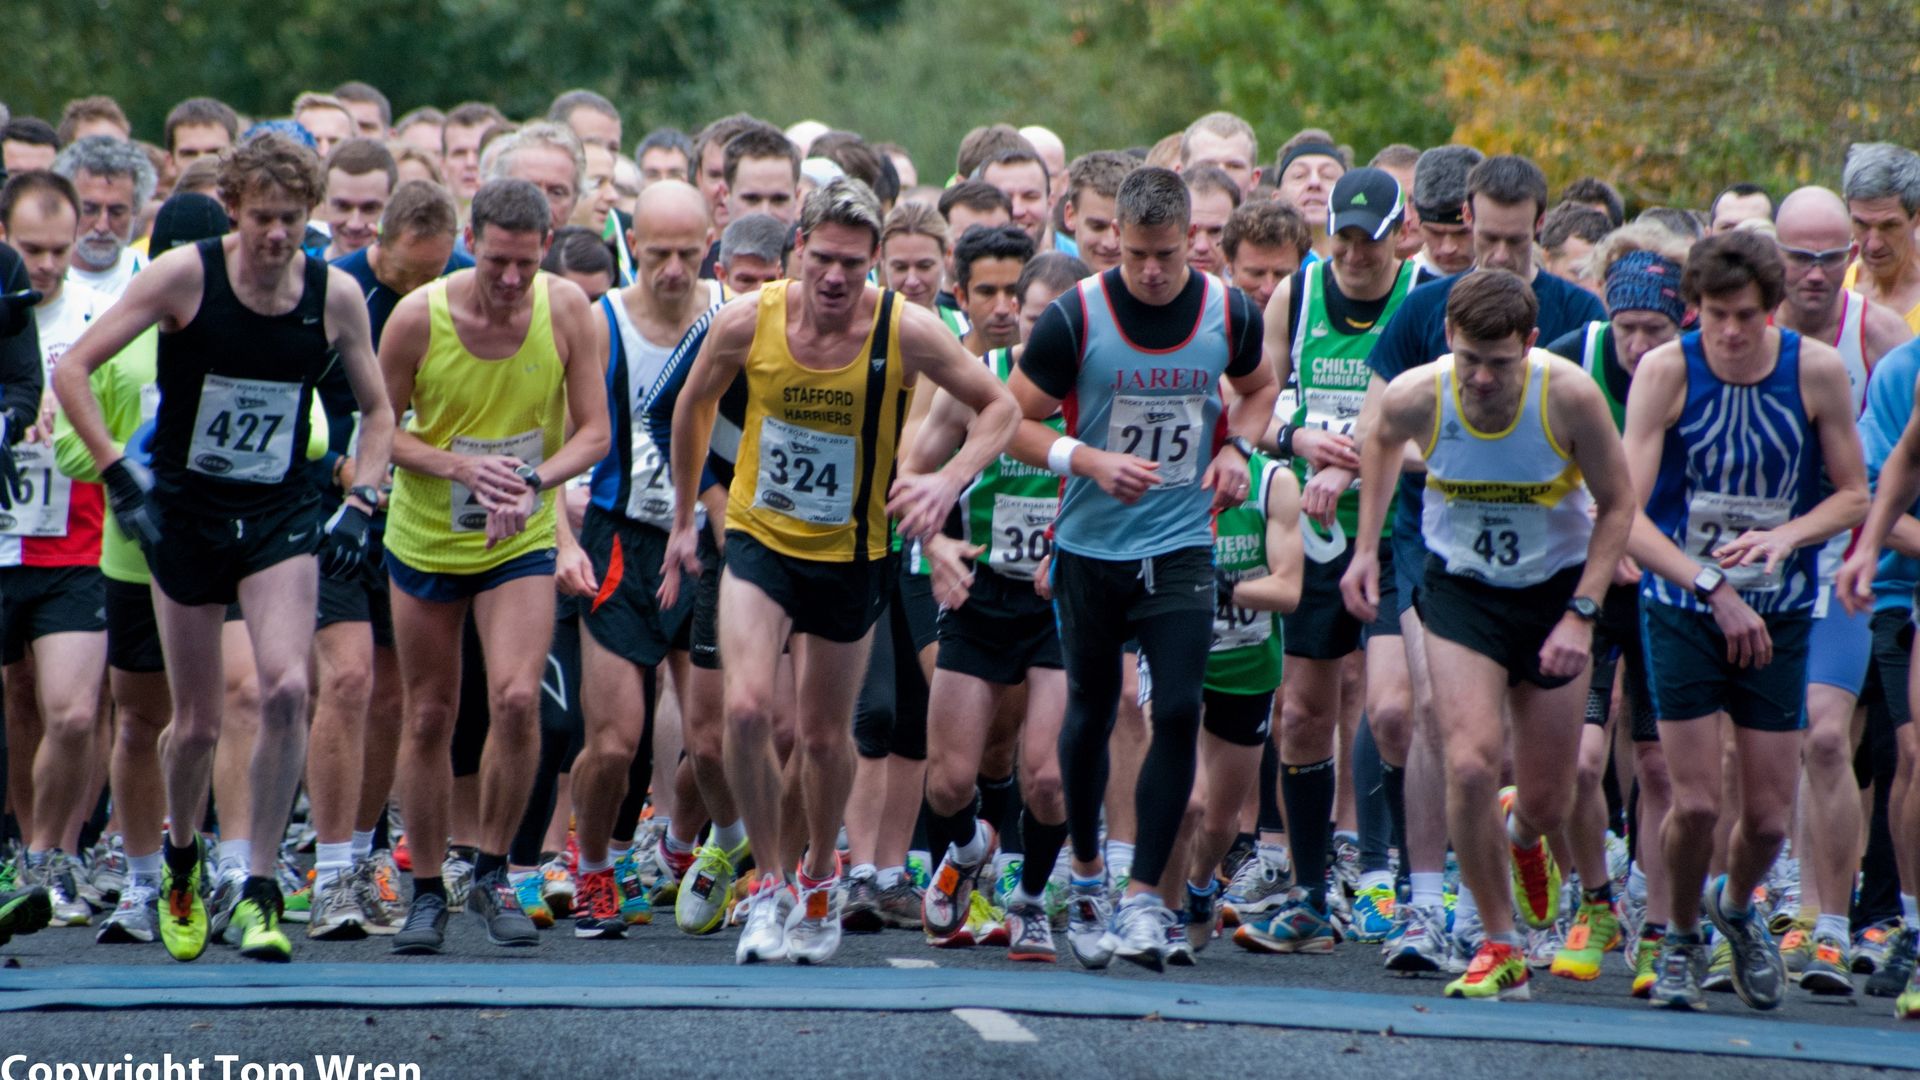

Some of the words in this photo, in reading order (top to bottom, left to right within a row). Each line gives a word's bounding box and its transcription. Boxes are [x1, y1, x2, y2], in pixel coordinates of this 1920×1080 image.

[1110, 367, 1209, 390] JARED
[1312, 374, 1367, 387] HARRIERS
[783, 387, 854, 406] STAFFORD
[784, 409, 852, 426] HARRIERS
[206, 409, 285, 453] 427
[788, 427, 810, 438] ROAD
[810, 434, 829, 443] RUN
[829, 437, 849, 445] 2012
[1121, 424, 1191, 462] 215
[769, 448, 839, 497] 324
[1473, 529, 1520, 566] 43
